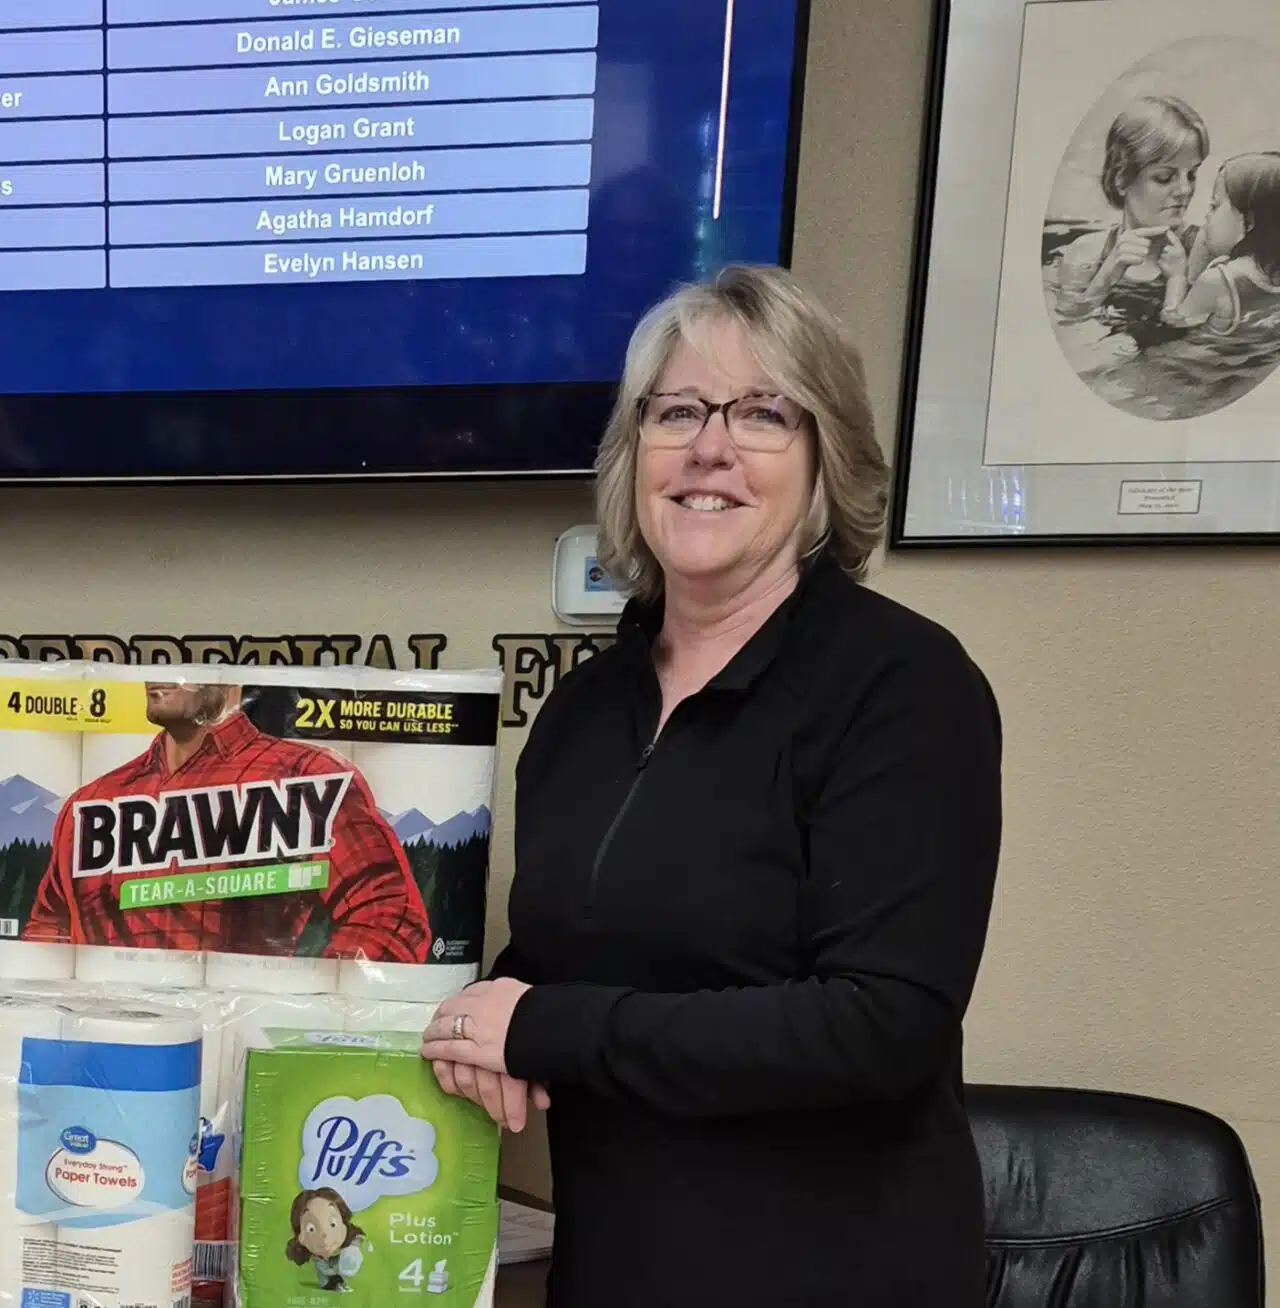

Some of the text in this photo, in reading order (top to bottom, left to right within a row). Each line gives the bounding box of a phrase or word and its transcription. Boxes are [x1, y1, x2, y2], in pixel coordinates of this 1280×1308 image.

[237, 26, 461, 53] Donald E. Gieseman
[264, 69, 430, 97] Ann Goldsmith
[279, 117, 415, 145] Logan Grant
[265, 160, 425, 189] Mary Gruenloh
[255, 204, 434, 234] Agatha Hamdorf
[263, 250, 424, 277] Evelyn Hansen
[7, 688, 106, 718] 4 DOUBLE 8
[295, 698, 335, 728] 2X
[340, 700, 453, 721] MORE DURABLE
[339, 719, 353, 730] SO
[356, 720, 375, 731] YOU
[379, 720, 400, 731] CAN
[403, 722, 424, 734] USE
[76, 776, 346, 873] BRAWNY
[130, 871, 277, 904] TEAR-A-SQUARE
[63, 1158, 96, 1170] Everyday
[312, 1116, 416, 1186] Puffs
[55, 1167, 137, 1188] Paper Towels
[388, 1211, 436, 1228] Plus
[389, 1230, 452, 1245] Lotion
[398, 1258, 424, 1287] 4
